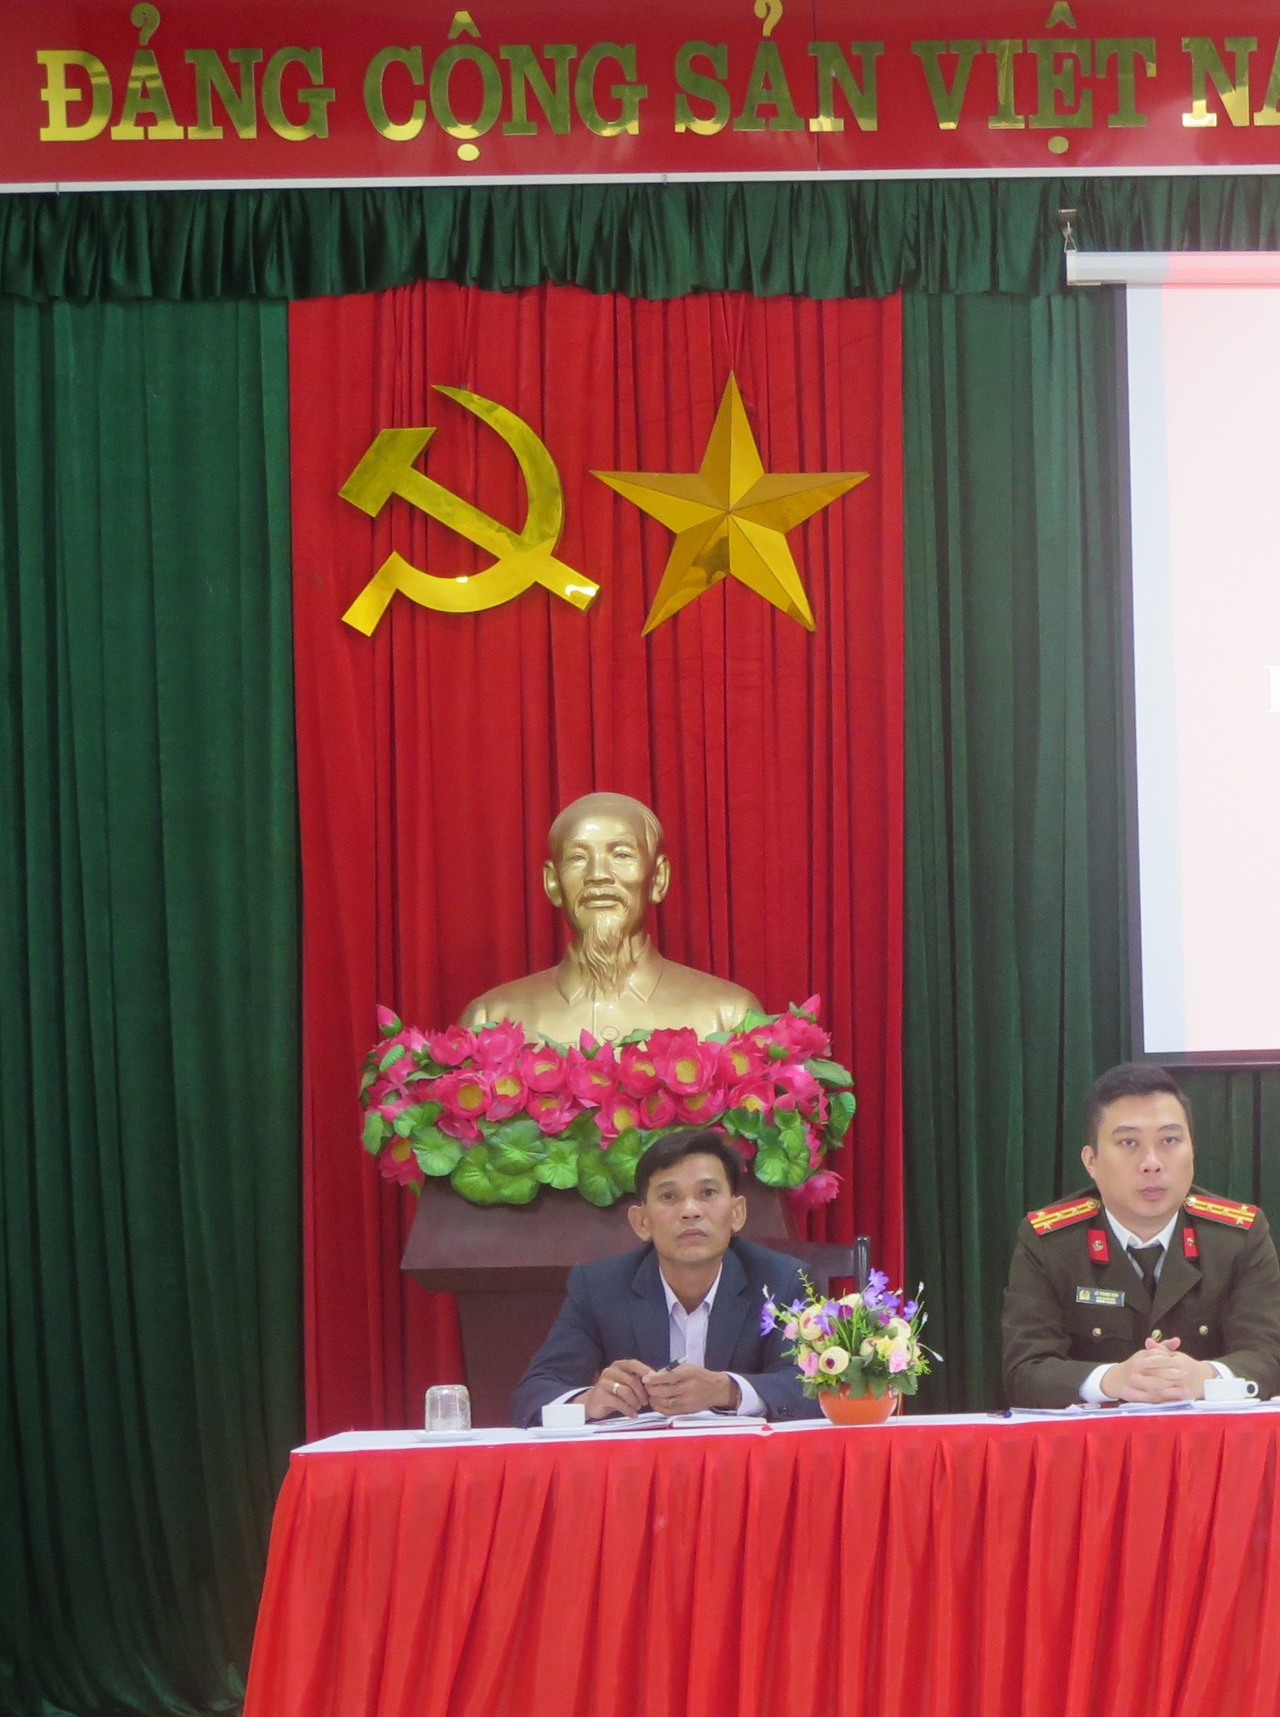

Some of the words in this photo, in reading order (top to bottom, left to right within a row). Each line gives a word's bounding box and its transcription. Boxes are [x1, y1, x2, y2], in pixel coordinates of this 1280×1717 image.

[36, 3, 336, 142] ĐẢNG
[363, 10, 648, 162] CỘNG
[674, 0, 884, 135] SẢN
[911, 0, 1157, 154] VIỆT
